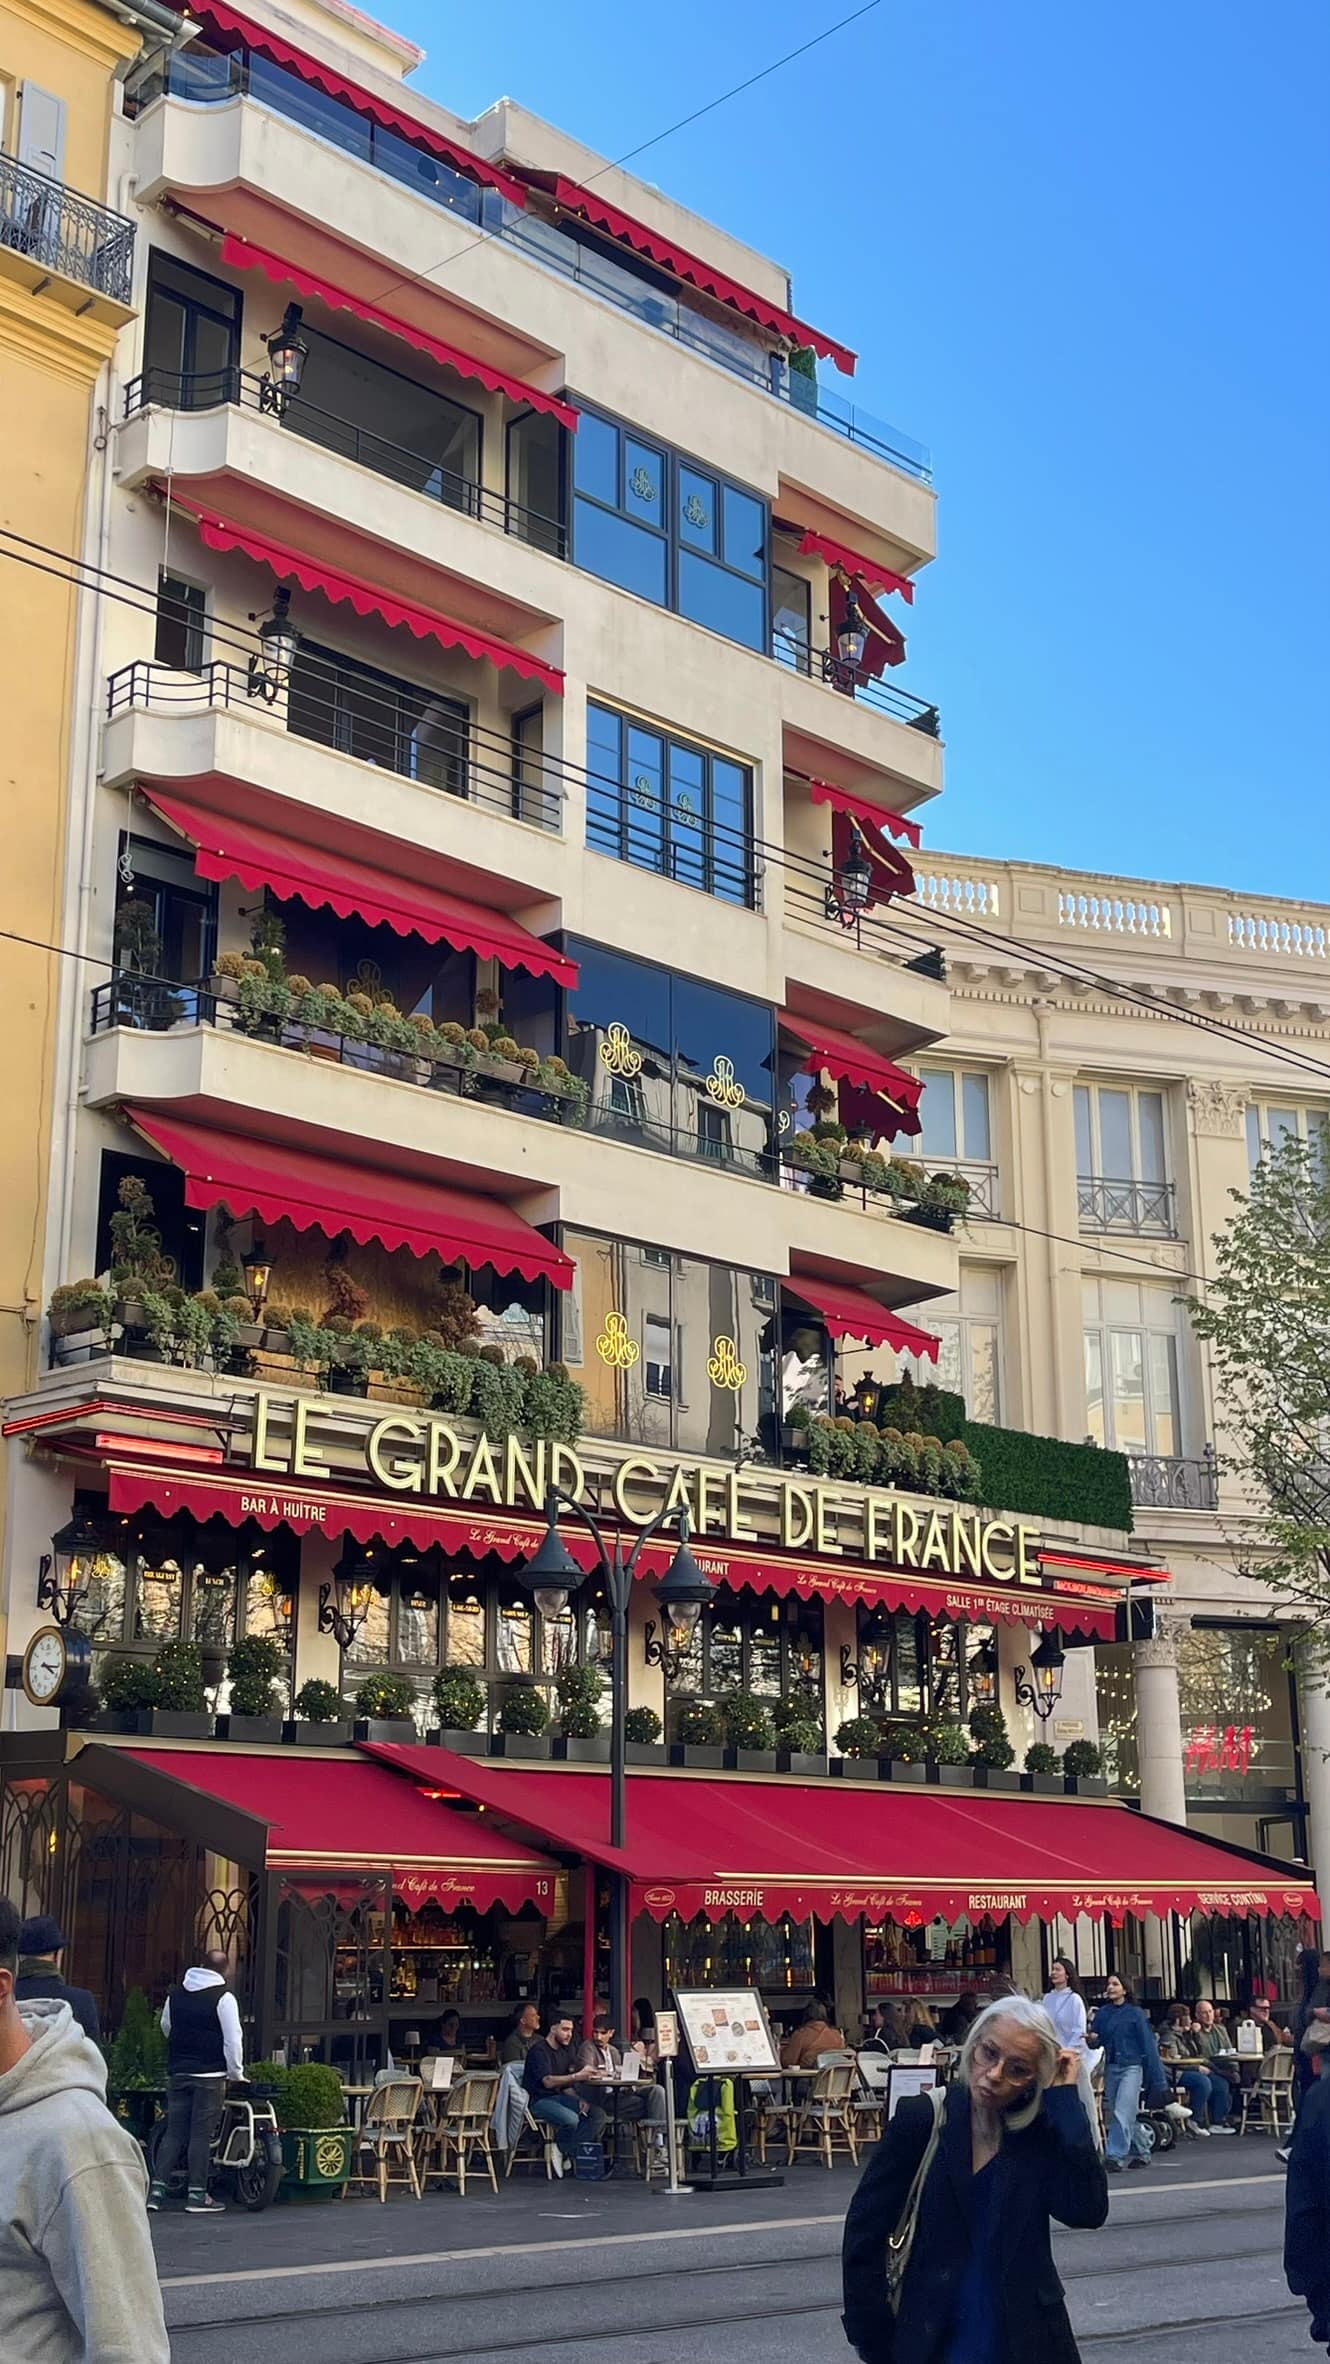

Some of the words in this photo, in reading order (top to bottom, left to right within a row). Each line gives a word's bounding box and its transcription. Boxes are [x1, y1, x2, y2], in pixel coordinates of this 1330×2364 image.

[252, 1391, 334, 1478] LE
[365, 1415, 585, 1513] GRAND
[612, 1457, 759, 1543] CAFE
[780, 1483, 844, 1556] DE
[864, 1497, 1043, 1587] FRANCE
[241, 1496, 266, 1514] BAR
[269, 1497, 279, 1515] À
[469, 1527, 481, 1541] Le
[946, 1594, 971, 1609] SALLE
[536, 1880, 548, 1896] 13
[968, 1894, 1027, 1909] RESTAURANT
